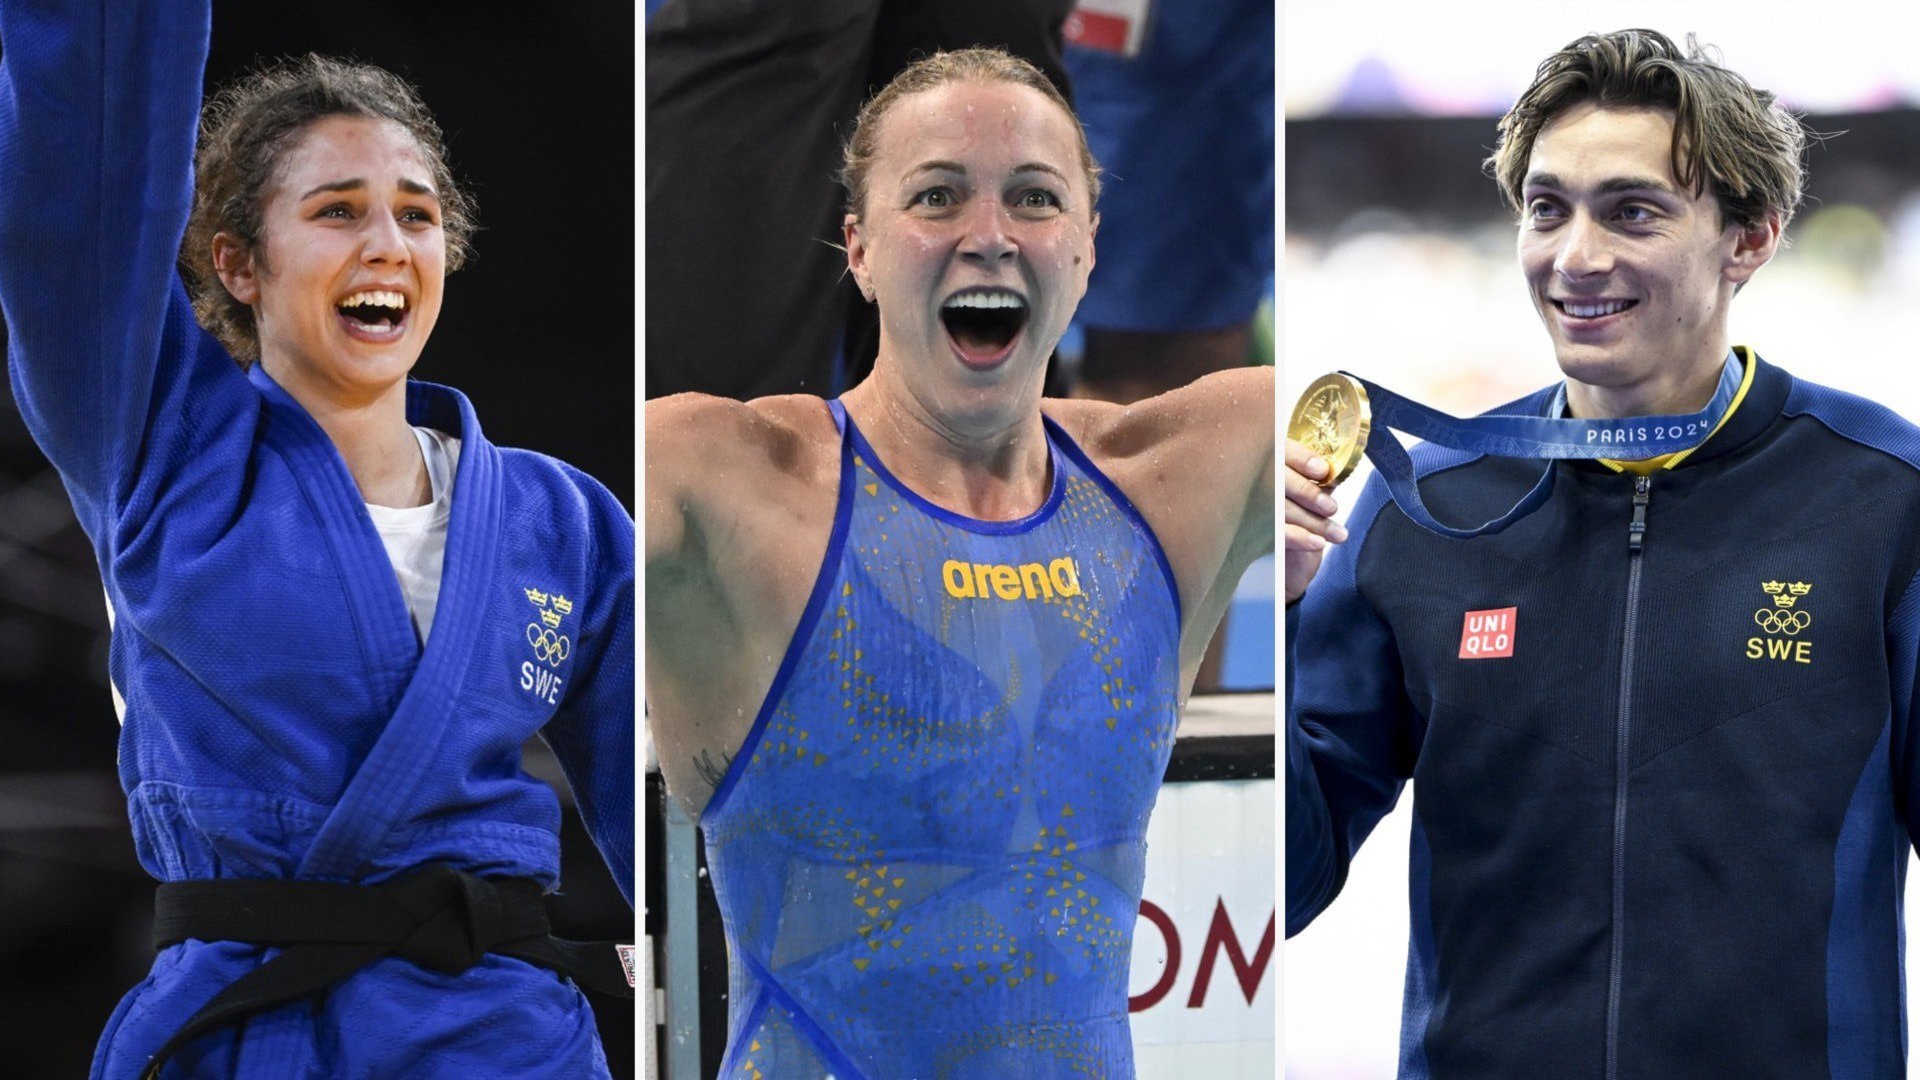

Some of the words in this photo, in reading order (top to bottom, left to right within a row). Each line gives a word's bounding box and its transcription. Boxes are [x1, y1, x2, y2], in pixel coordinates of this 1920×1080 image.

[1654, 420, 1708, 440] 2024
[942, 556, 1081, 600] arena
[1469, 613, 1507, 633] UNI
[1466, 634, 1509, 654] QLO
[1746, 637, 1812, 664] SWE
[520, 661, 562, 705] SWE
